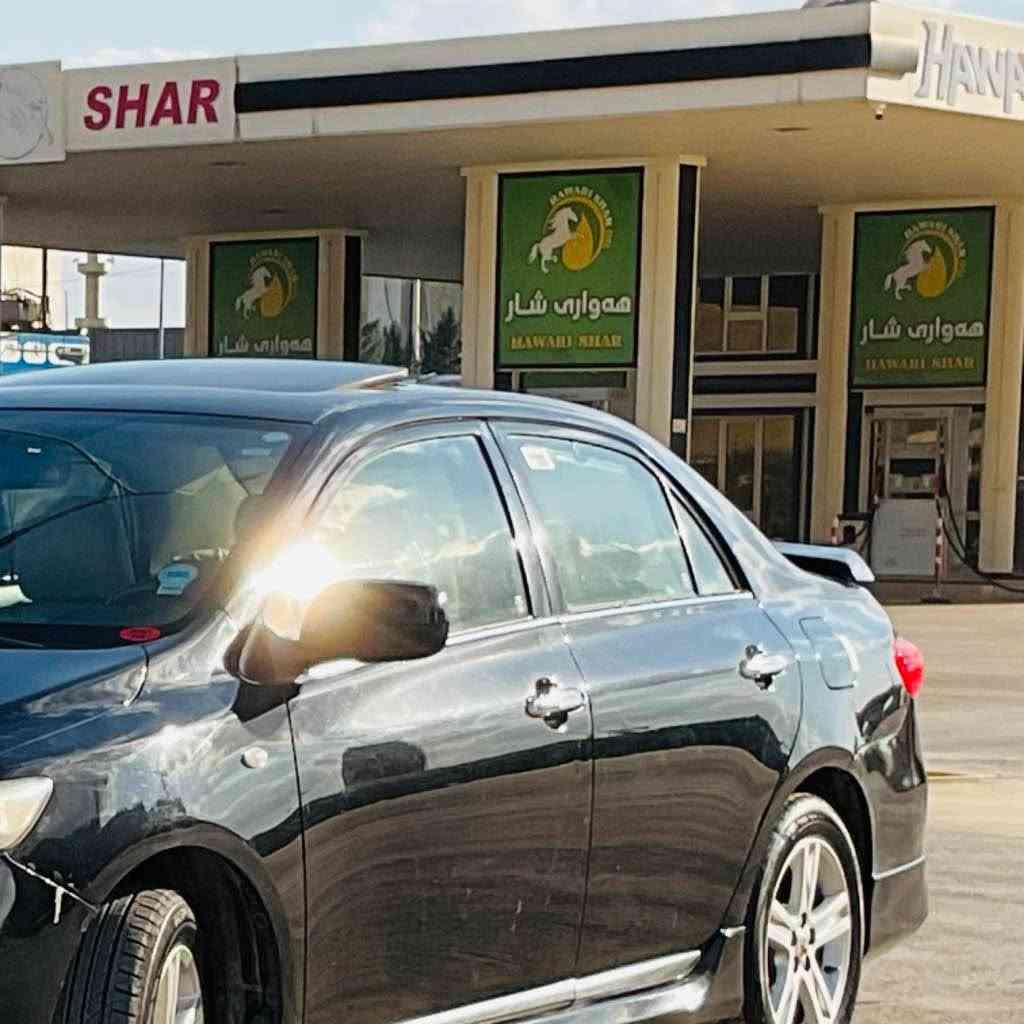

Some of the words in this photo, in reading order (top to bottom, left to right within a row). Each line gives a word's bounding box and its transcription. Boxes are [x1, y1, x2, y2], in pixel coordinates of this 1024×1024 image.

[83, 79, 220, 131] SHAR
[504, 289, 548, 322] شار
[859, 315, 902, 346] شار
